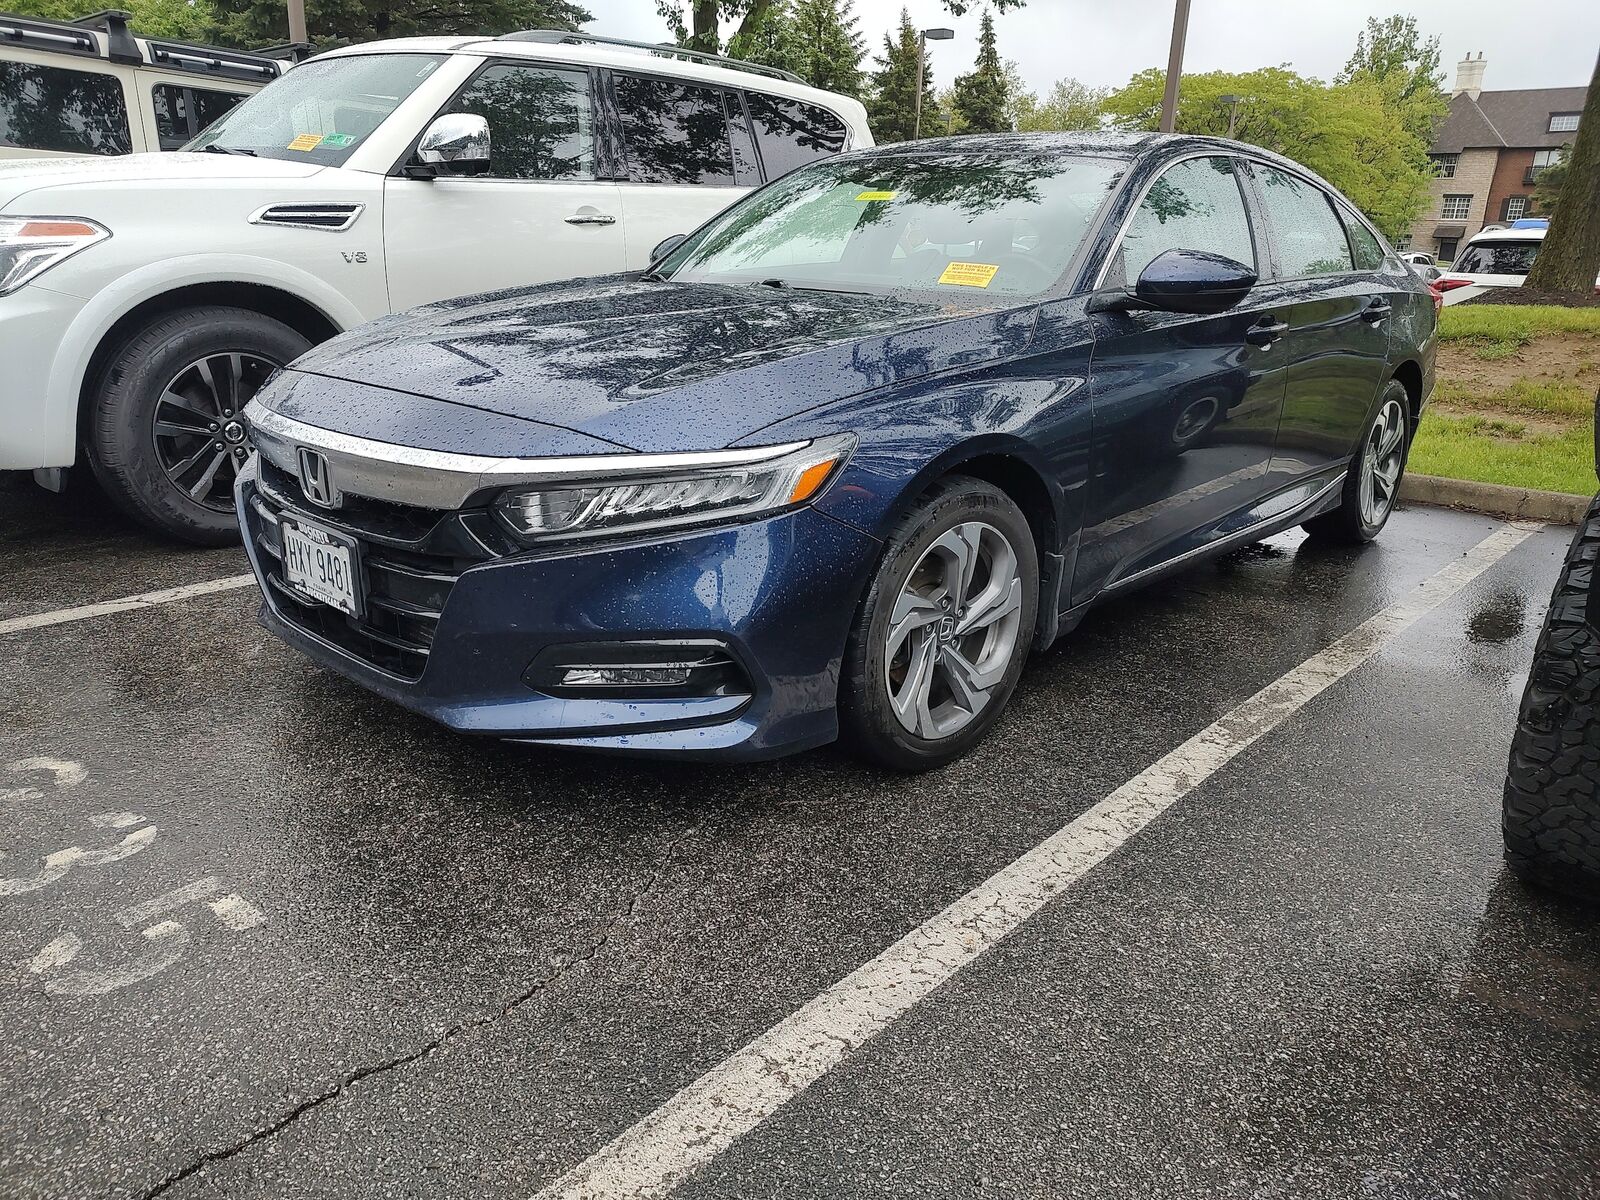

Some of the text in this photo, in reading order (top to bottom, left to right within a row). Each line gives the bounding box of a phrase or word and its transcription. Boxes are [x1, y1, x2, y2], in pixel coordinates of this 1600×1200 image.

[340, 251, 368, 263] V8
[287, 535, 352, 596] HXY 9481
